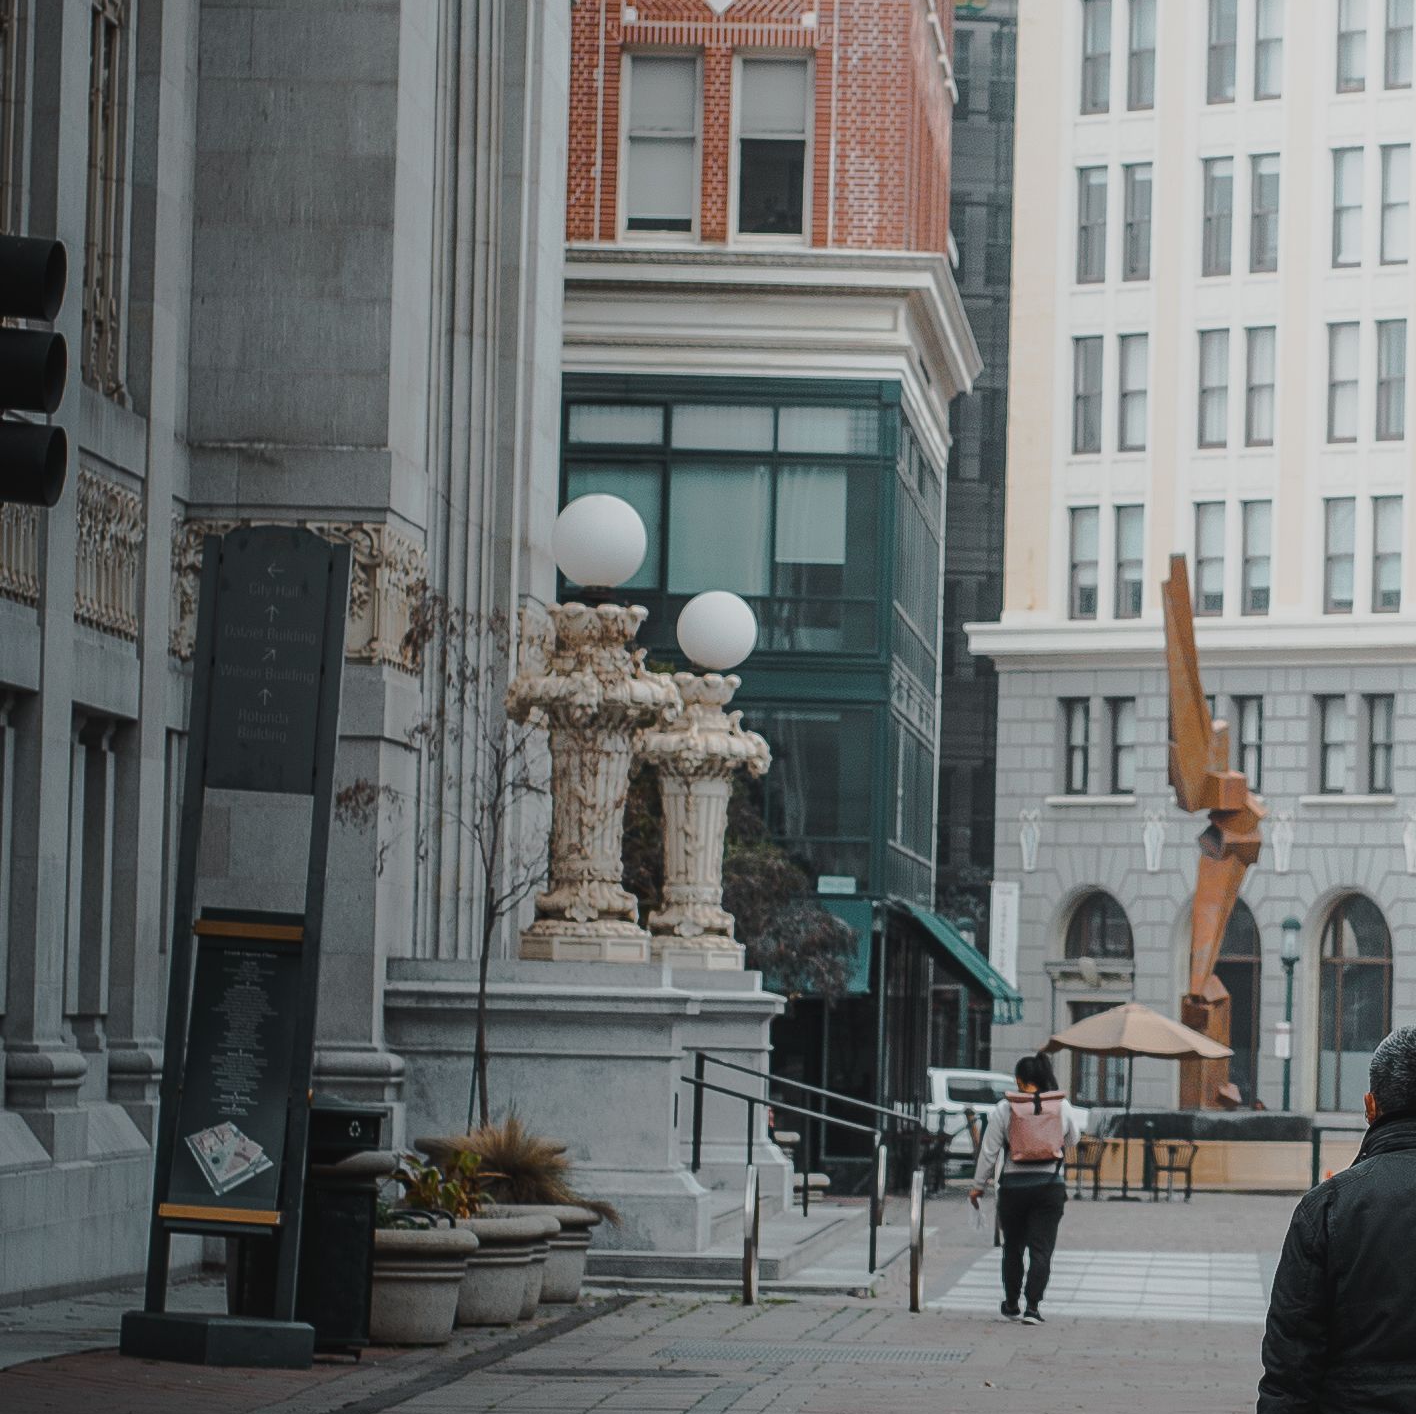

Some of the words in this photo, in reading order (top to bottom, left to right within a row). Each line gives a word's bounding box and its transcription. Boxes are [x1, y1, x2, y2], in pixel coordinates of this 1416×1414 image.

[267, 627, 316, 645] Building
[264, 667, 314, 684] Building
[237, 725, 287, 743] Building
